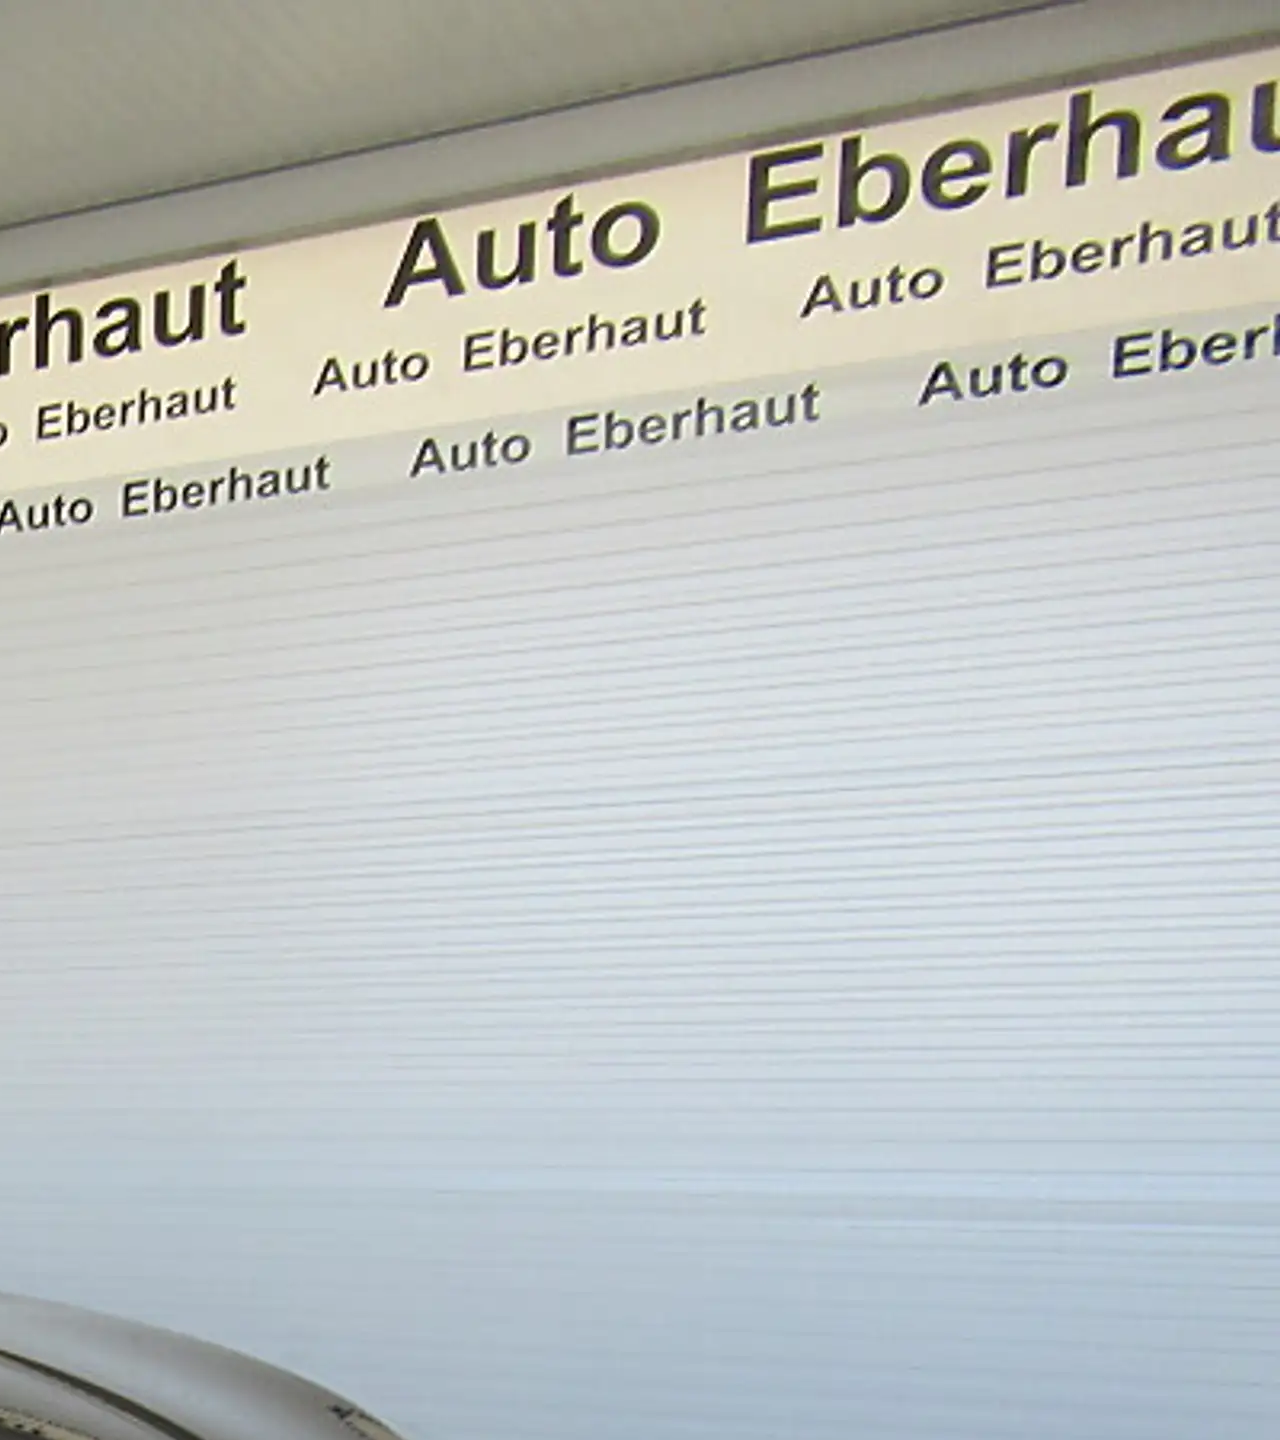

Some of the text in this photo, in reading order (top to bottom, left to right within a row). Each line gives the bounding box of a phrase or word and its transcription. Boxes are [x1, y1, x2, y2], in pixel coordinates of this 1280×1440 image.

[383, 194, 659, 308] Auto
[801, 266, 943, 317] Auto
[314, 298, 705, 395] Auto Eberhaut
[38, 378, 234, 439] Eberhaut
[919, 354, 1067, 405] Auto
[411, 384, 819, 477] Auto Eberhaut
[123, 457, 329, 516] Eberhaut
